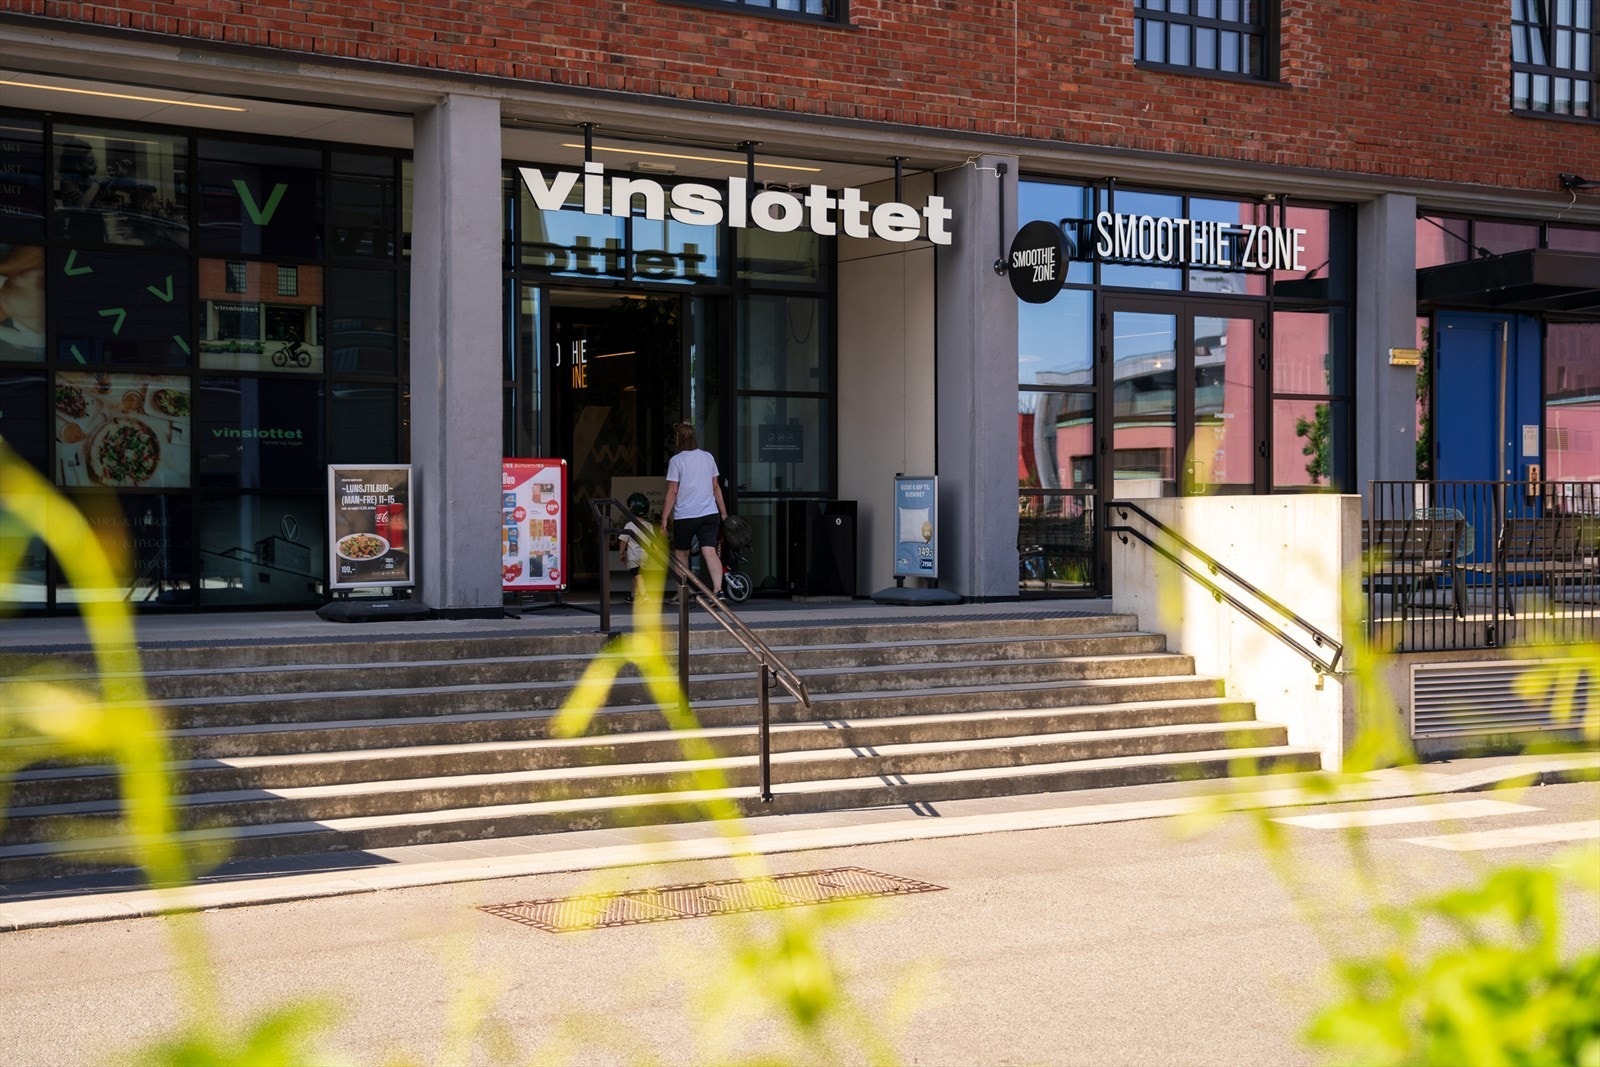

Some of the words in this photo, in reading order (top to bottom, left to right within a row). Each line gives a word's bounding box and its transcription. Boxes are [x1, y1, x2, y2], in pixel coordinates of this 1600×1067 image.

[518, 161, 952, 245] vinslottet
[1096, 211, 1231, 267] SMOOTHIE
[1241, 223, 1307, 272] ZONE
[1012, 246, 1055, 268] SMOOTHIE
[1033, 263, 1055, 283] ZONE
[214, 303, 259, 313] vinslottet
[211, 427, 303, 439] vinslottet
[134, 537, 171, 548] HYGGE
